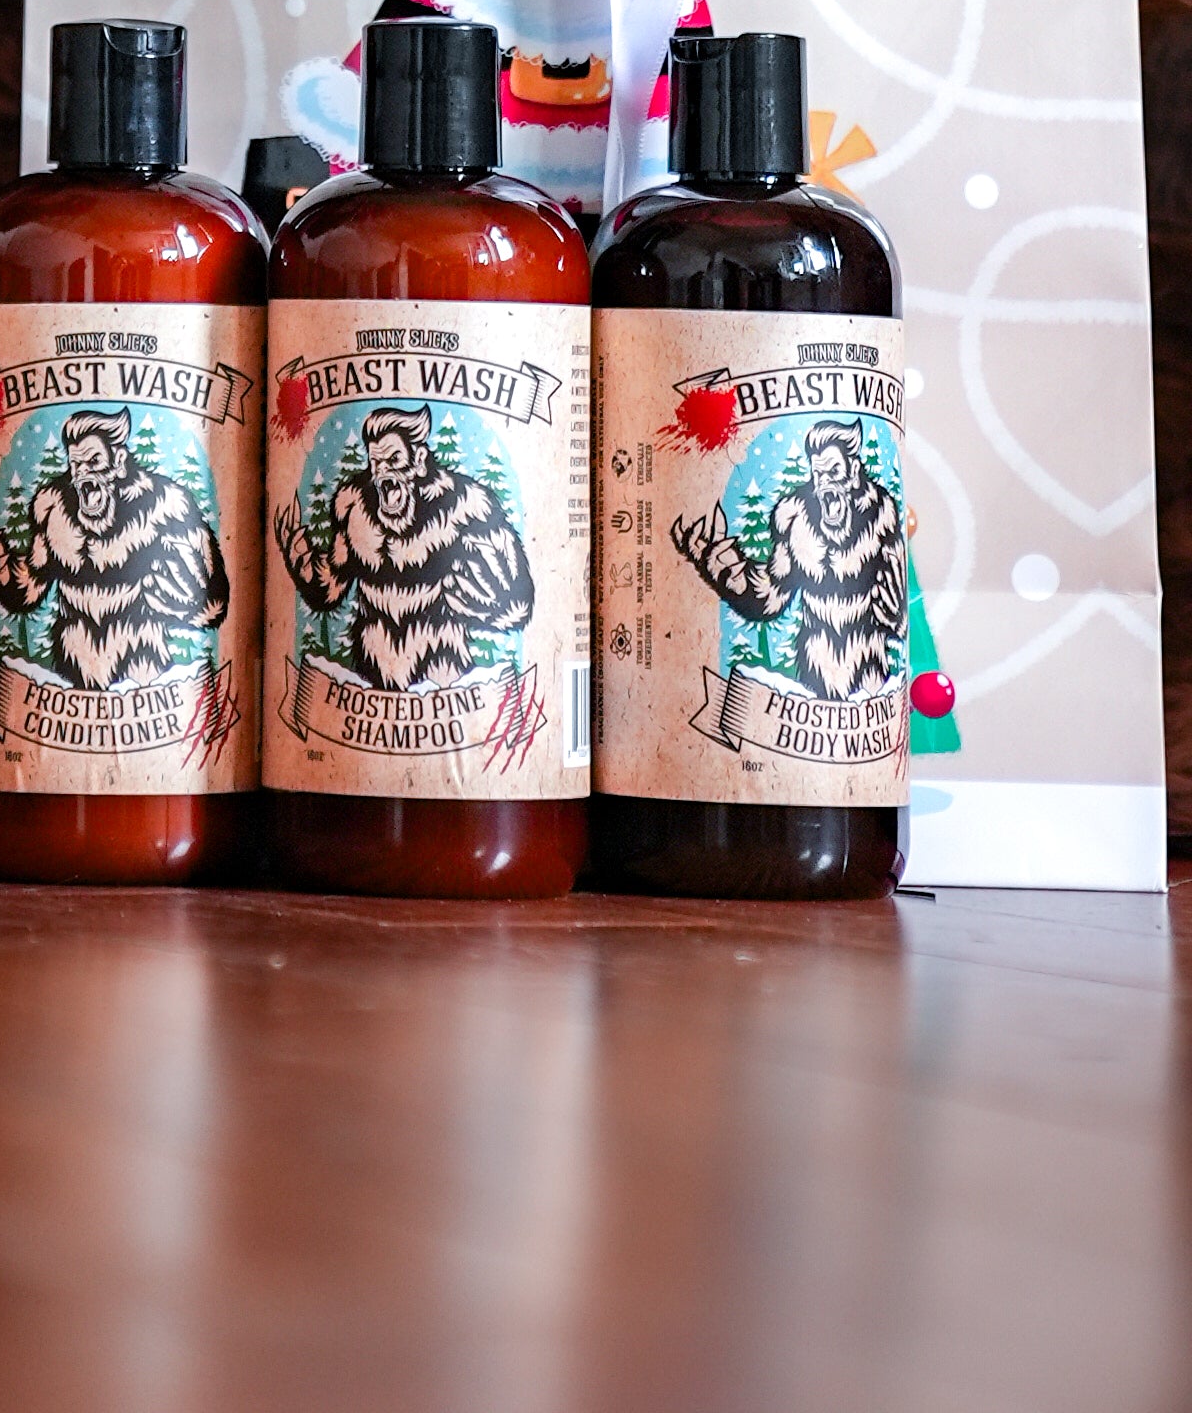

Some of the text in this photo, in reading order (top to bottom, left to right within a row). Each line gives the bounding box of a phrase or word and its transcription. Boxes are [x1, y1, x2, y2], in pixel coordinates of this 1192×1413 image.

[55, 332, 158, 356] JOHNNY SLICKS
[354, 329, 460, 352] JOHNNY SLICKS
[797, 342, 844, 366] JOHNNY
[2, 361, 214, 411] BEAST WASH
[308, 358, 518, 410] BEAST WASH
[736, 372, 904, 424] BEAST WASH
[636, 441, 644, 486] ETHICALLY
[645, 444, 653, 483] SOURCED
[636, 499, 644, 546] HANDMADE
[23, 682, 184, 721] FROSTED PINE
[324, 682, 486, 721] FROSTED PINE
[764, 691, 897, 730] FROSTED PINE
[23, 711, 183, 747] CONDITIONER
[341, 715, 465, 749] SHAMPOO
[776, 724, 893, 759] BODY WASH
